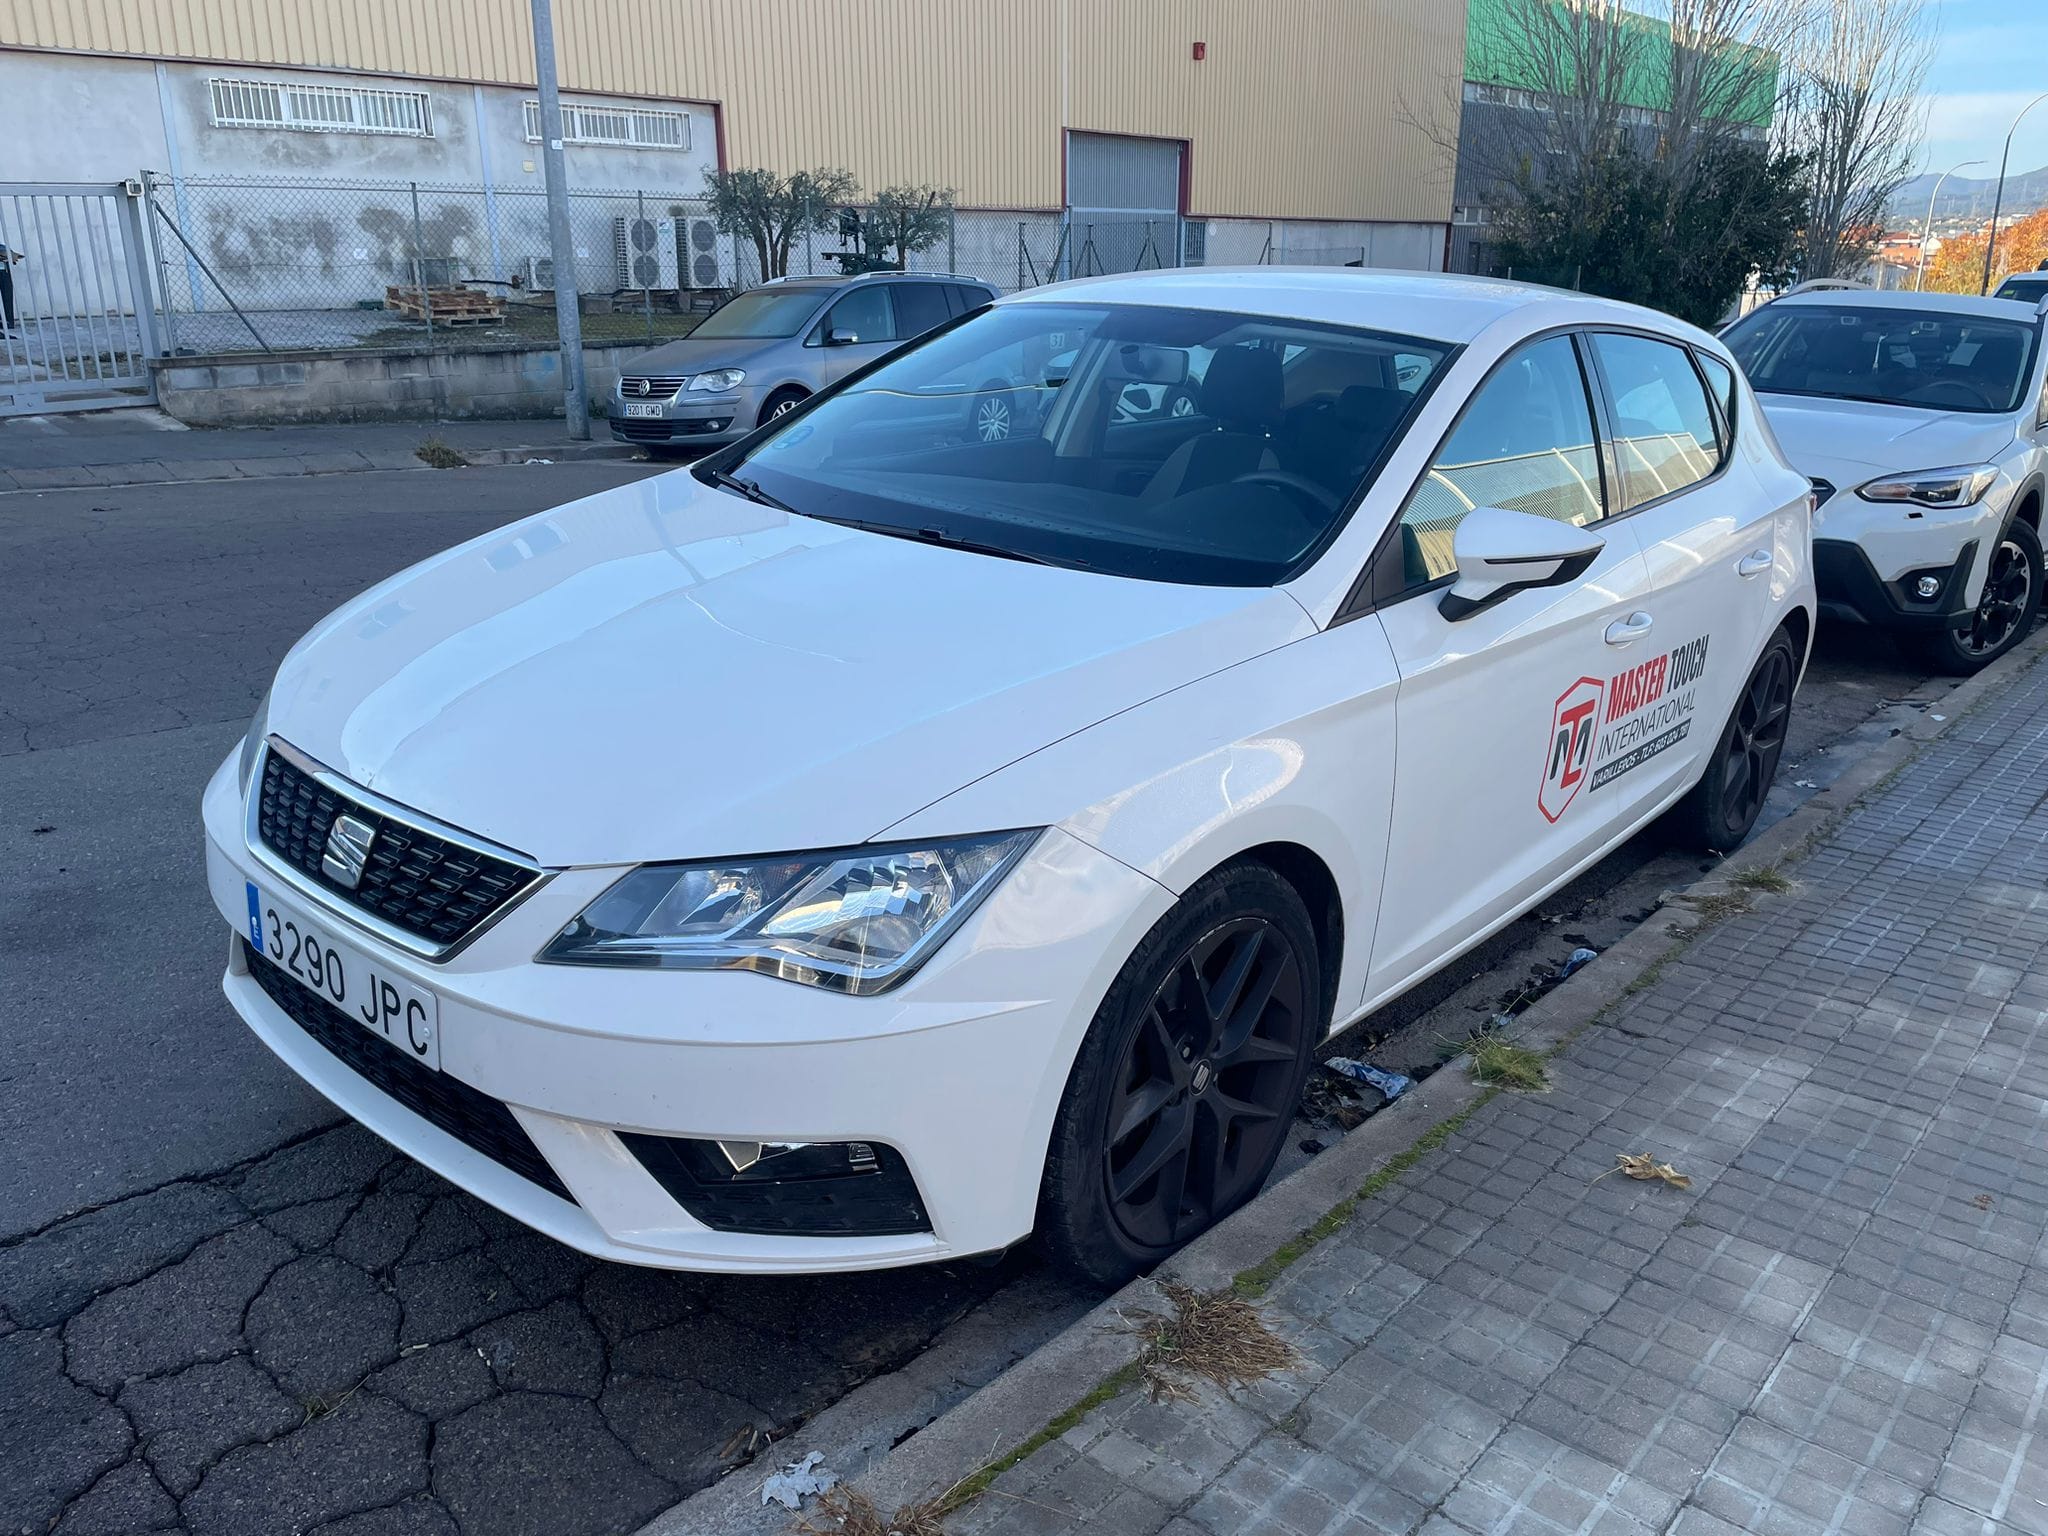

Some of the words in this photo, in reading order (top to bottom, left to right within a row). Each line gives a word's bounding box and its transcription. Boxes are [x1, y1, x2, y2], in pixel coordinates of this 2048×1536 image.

[627, 404, 644, 416] 9201
[1605, 654, 1668, 725] MASTER
[1667, 634, 1710, 694] TOUCH
[1597, 688, 1696, 762] INTERNATIONAL
[267, 908, 345, 1003] 3290
[360, 973, 428, 1056] JPC
